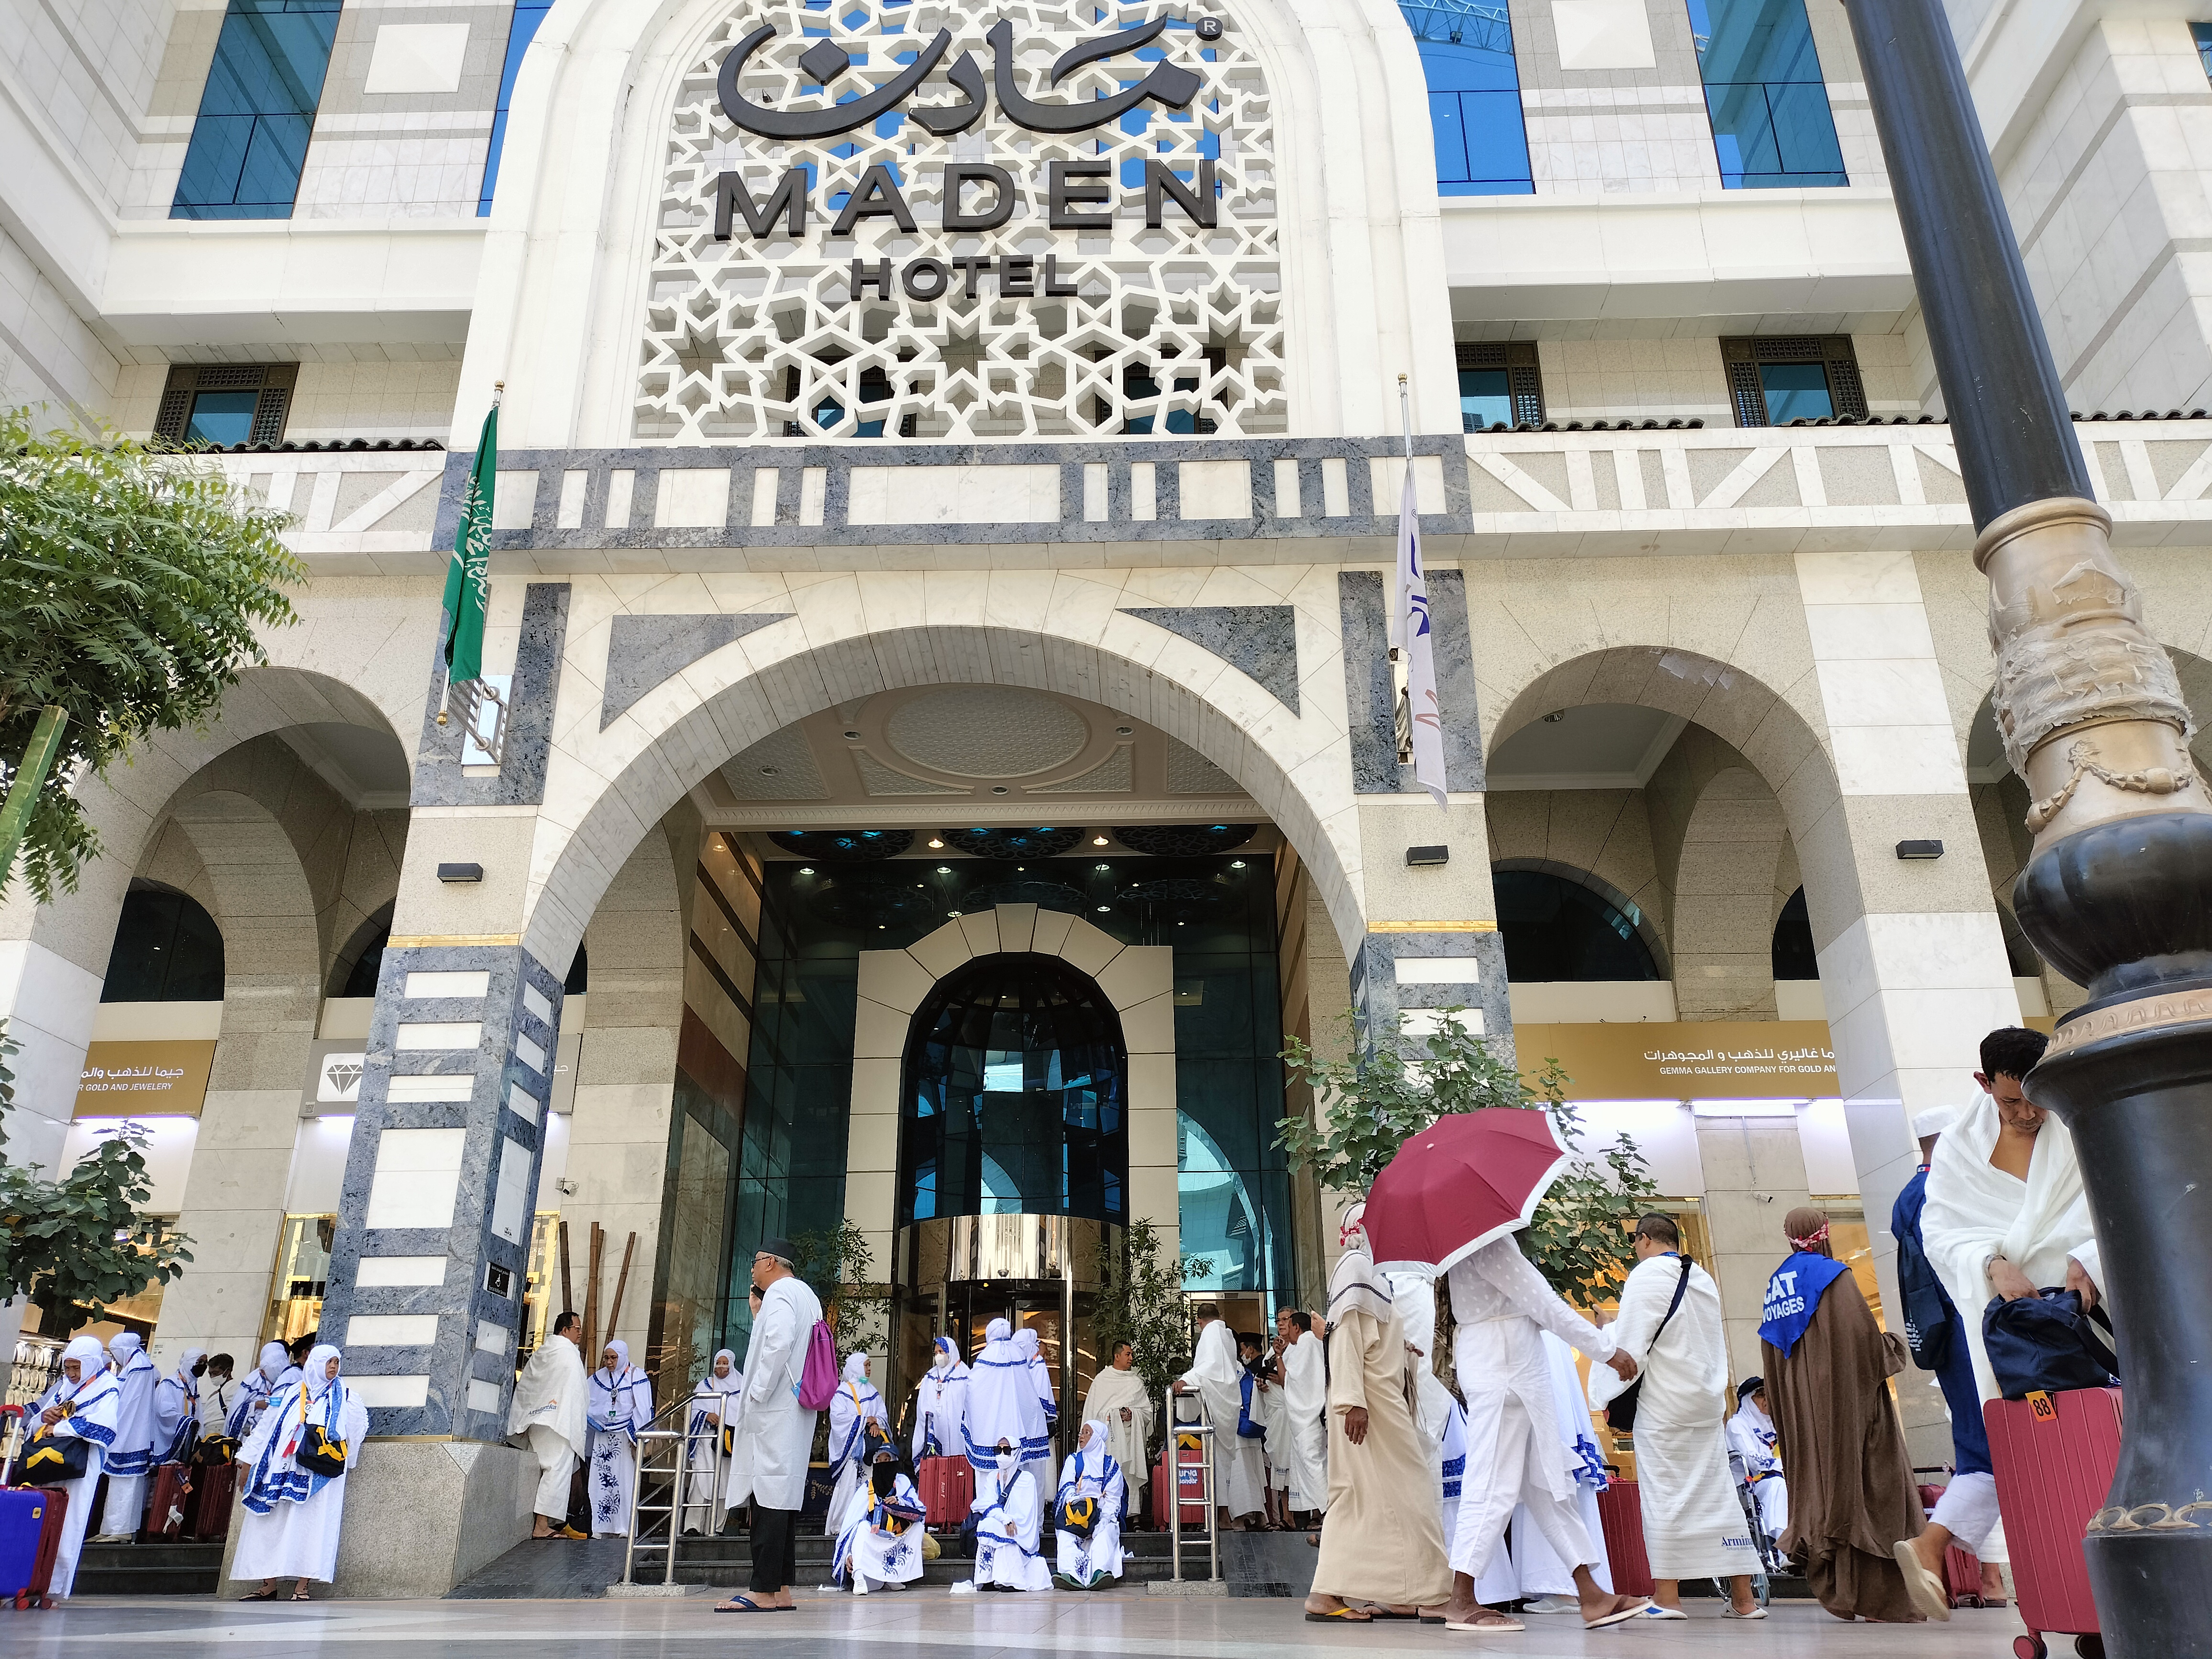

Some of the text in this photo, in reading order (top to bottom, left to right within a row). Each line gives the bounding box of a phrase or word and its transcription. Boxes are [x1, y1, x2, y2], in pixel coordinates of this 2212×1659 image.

[714, 158, 1217, 241] MADEN
[850, 253, 1078, 303] HOTEL
[1644, 1049, 1714, 1063] المجوهرات
[1717, 1052, 1725, 1062] و
[1727, 1048, 1774, 1062] للذهب
[1777, 1047, 1819, 1064] غاليري
[107, 1066, 153, 1080] للذهب
[155, 1066, 184, 1079] جيما
[1735, 1065, 1777, 1073] COMPANY
[85, 1083, 109, 1091] GOLD
[110, 1083, 129, 1091] AND
[129, 1083, 174, 1091] JEWELERY
[1764, 1270, 1798, 1305] CAT
[1762, 1296, 1804, 1324] VOYAGES
[2033, 1398, 2051, 1417] 88
